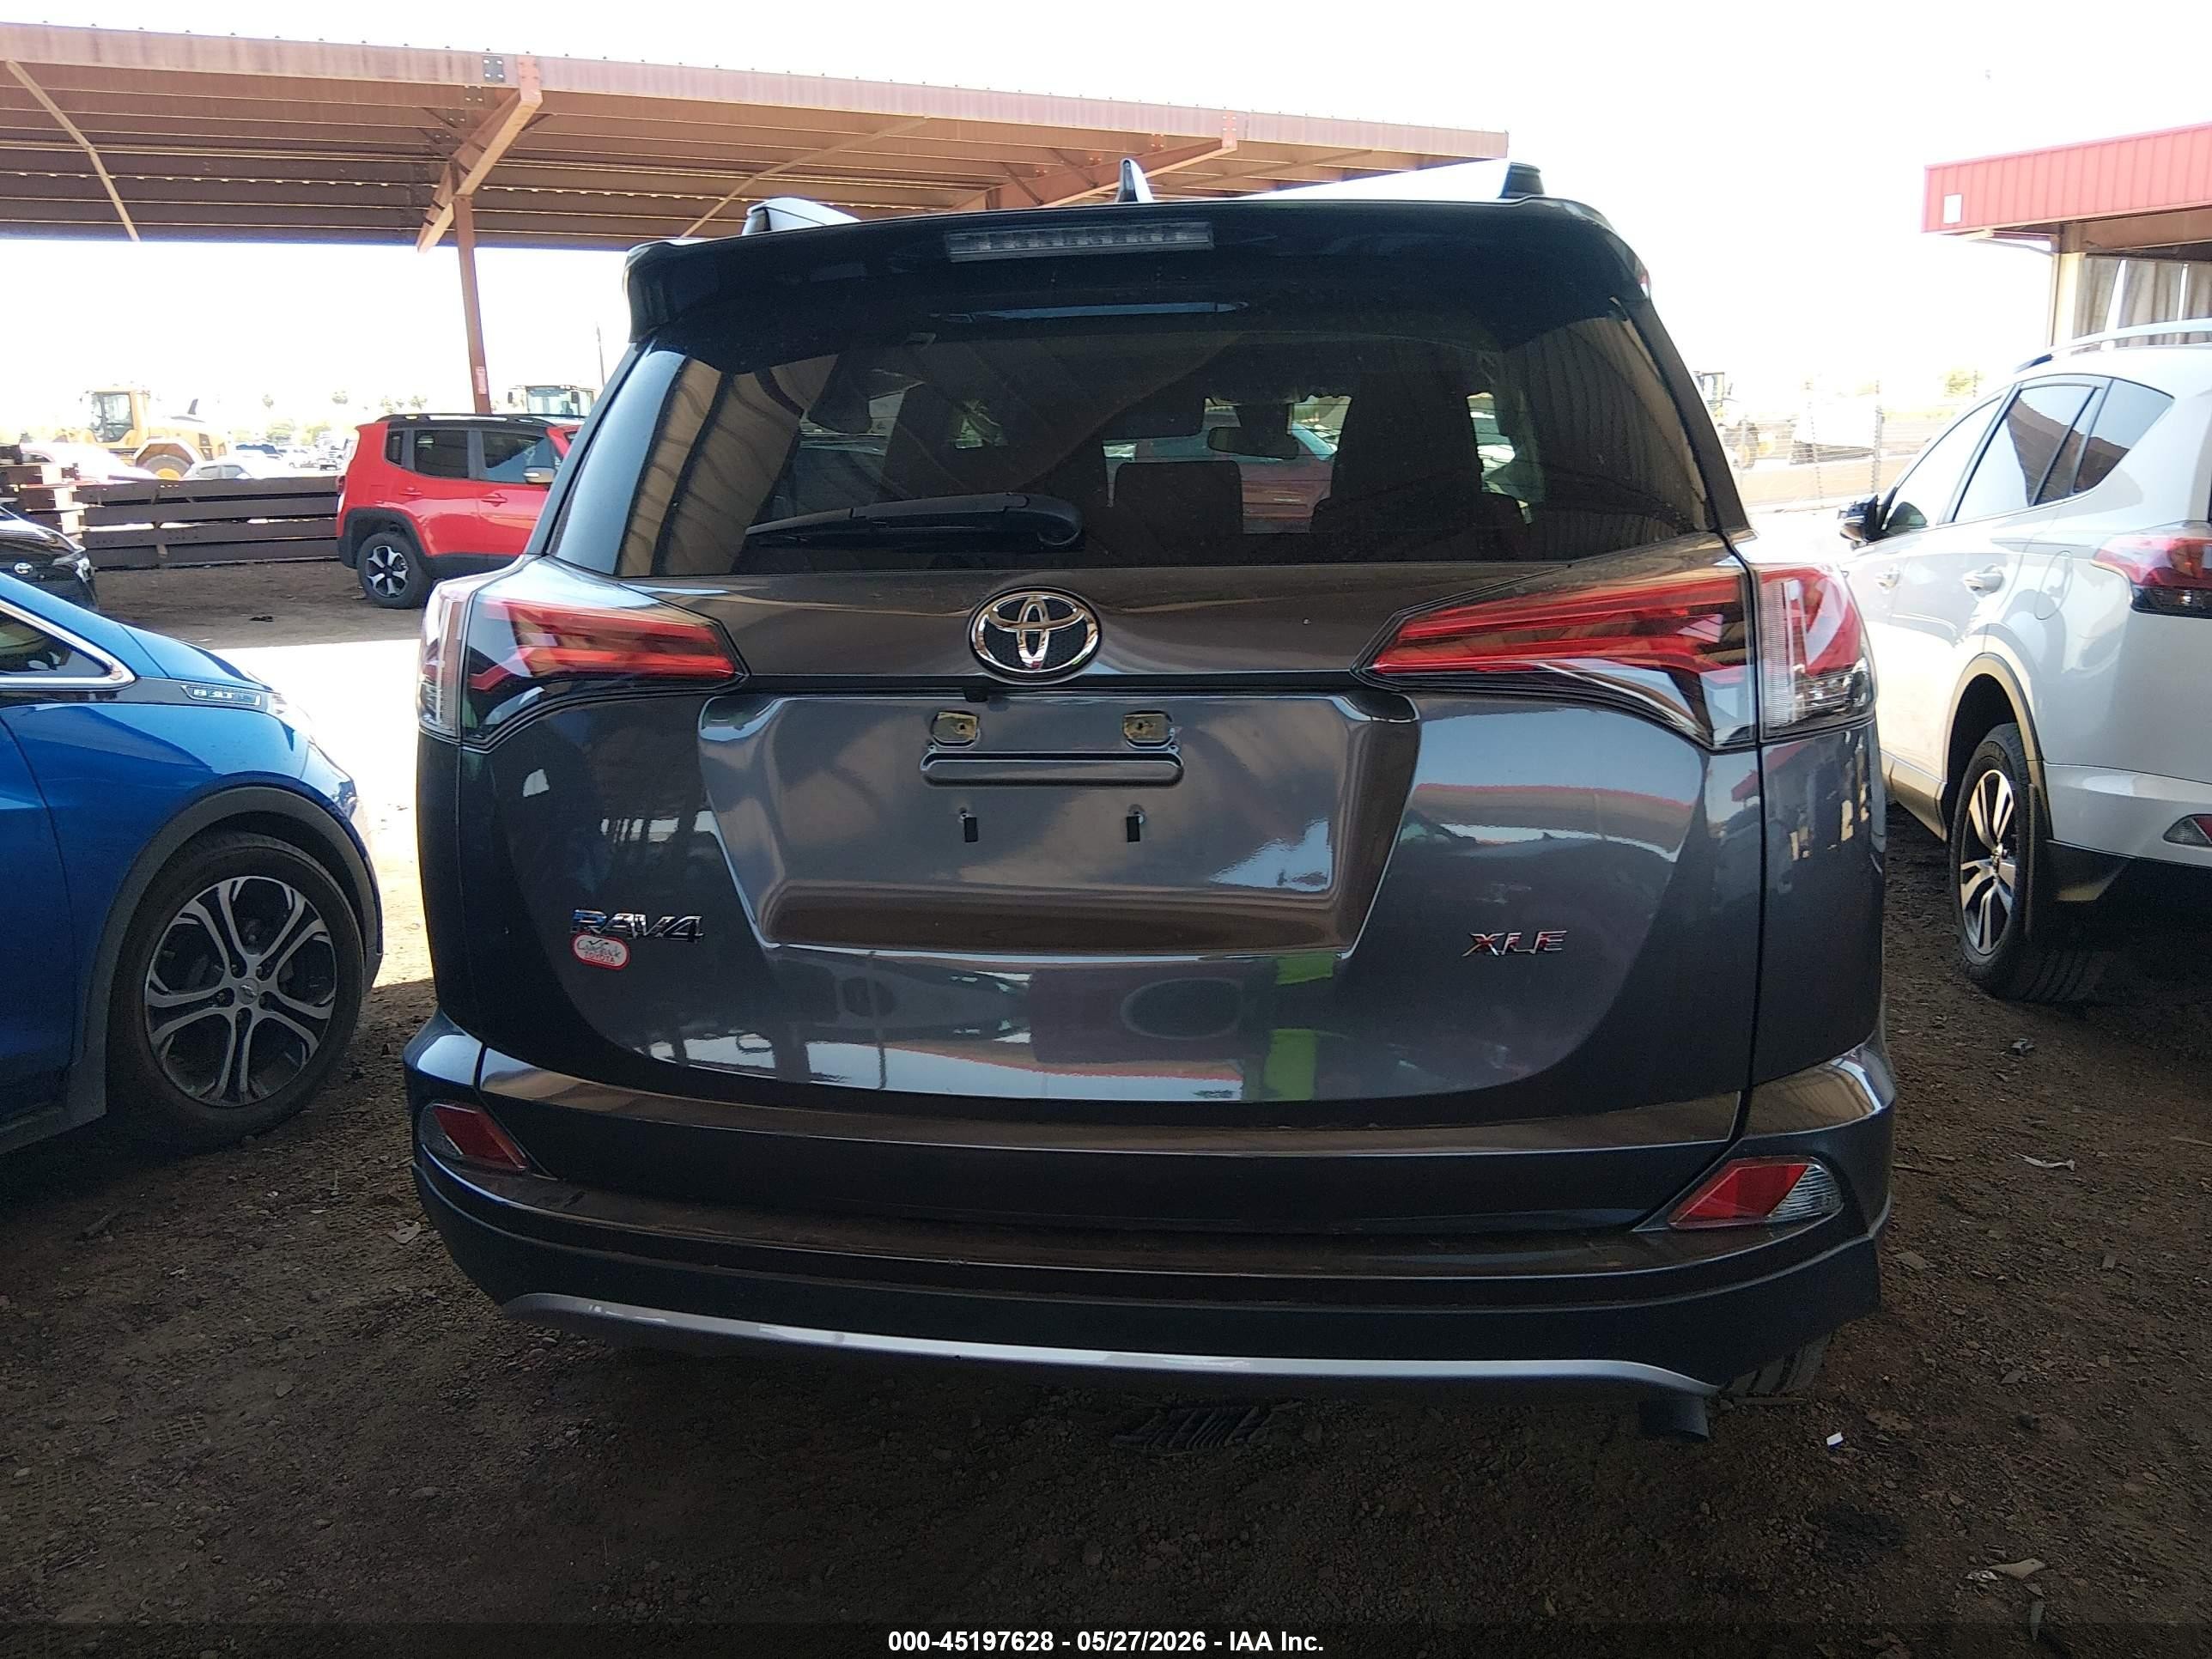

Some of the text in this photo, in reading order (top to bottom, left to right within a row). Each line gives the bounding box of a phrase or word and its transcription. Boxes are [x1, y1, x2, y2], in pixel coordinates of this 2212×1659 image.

[570, 908, 705, 943] RAV4
[584, 951, 616, 963] TOYOTA
[1462, 930, 1568, 957] XLE
